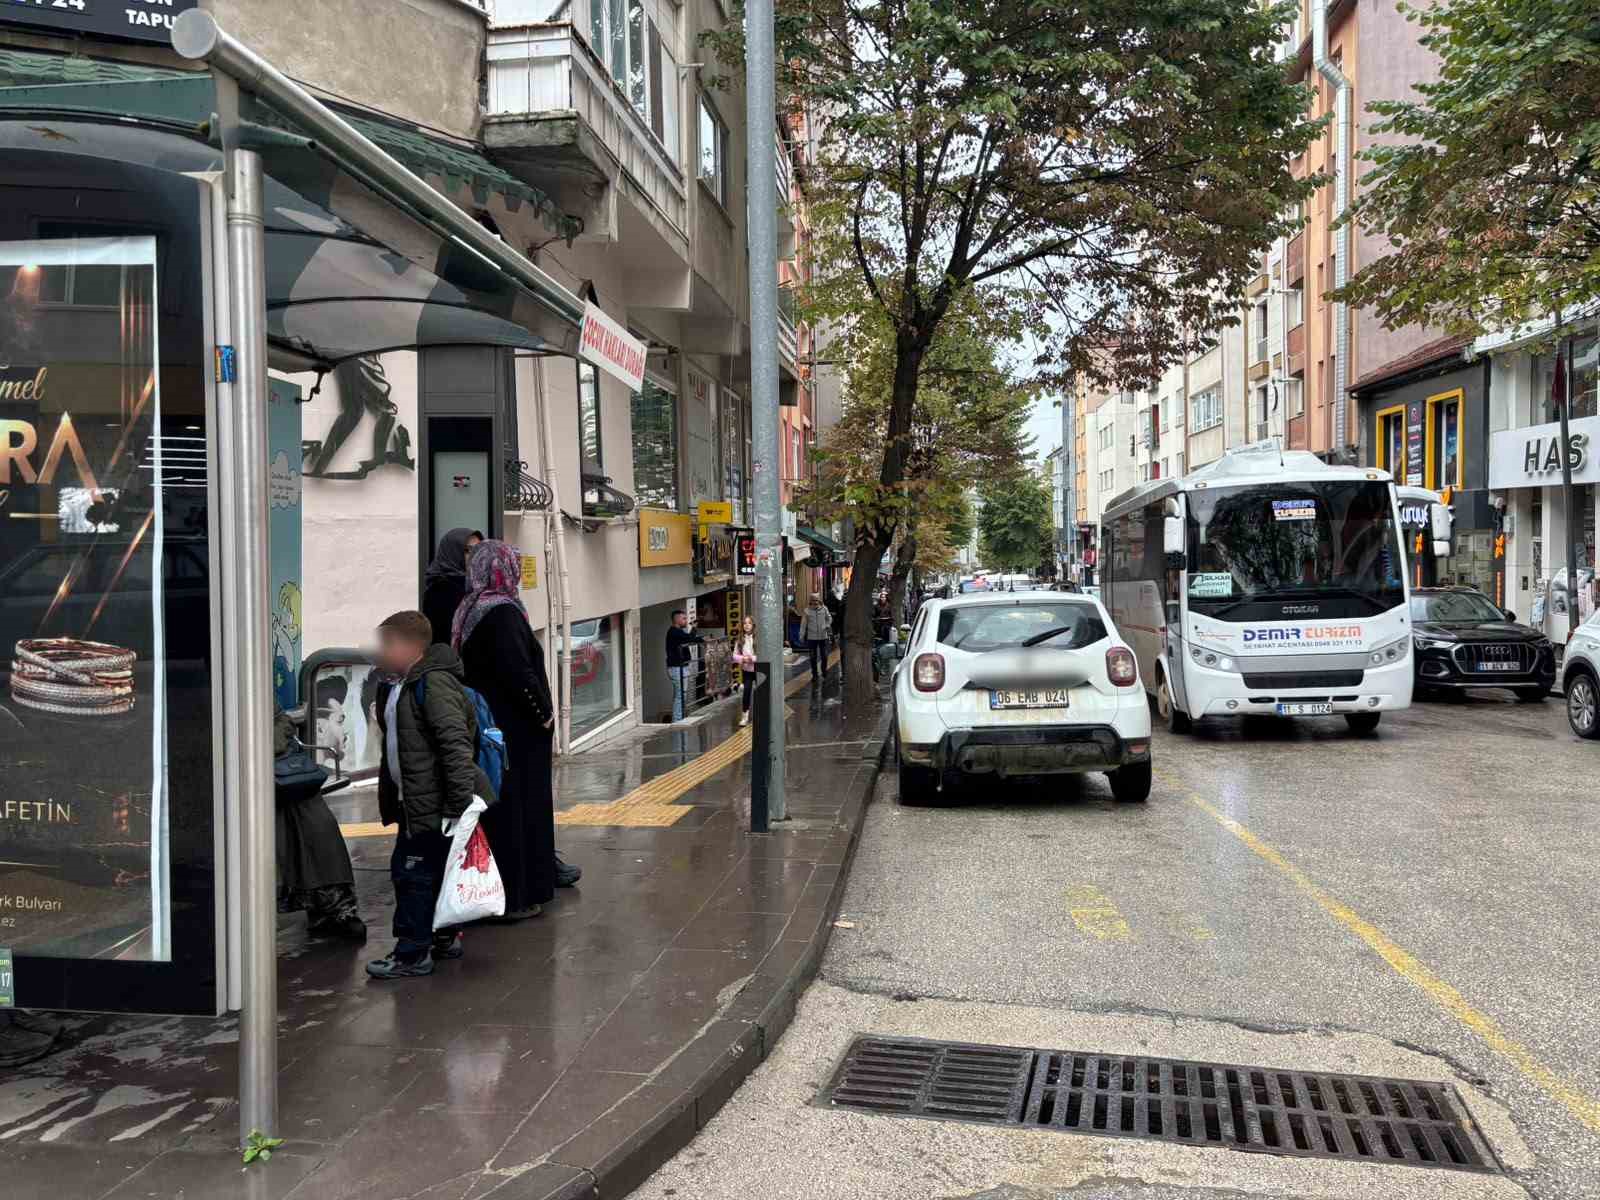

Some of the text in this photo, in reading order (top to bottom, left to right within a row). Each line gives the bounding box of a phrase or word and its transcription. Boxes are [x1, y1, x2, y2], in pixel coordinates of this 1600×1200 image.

[1524, 434, 1585, 473] HAS
[997, 691, 1011, 704] 06
[0, 797, 71, 822] FETİN
